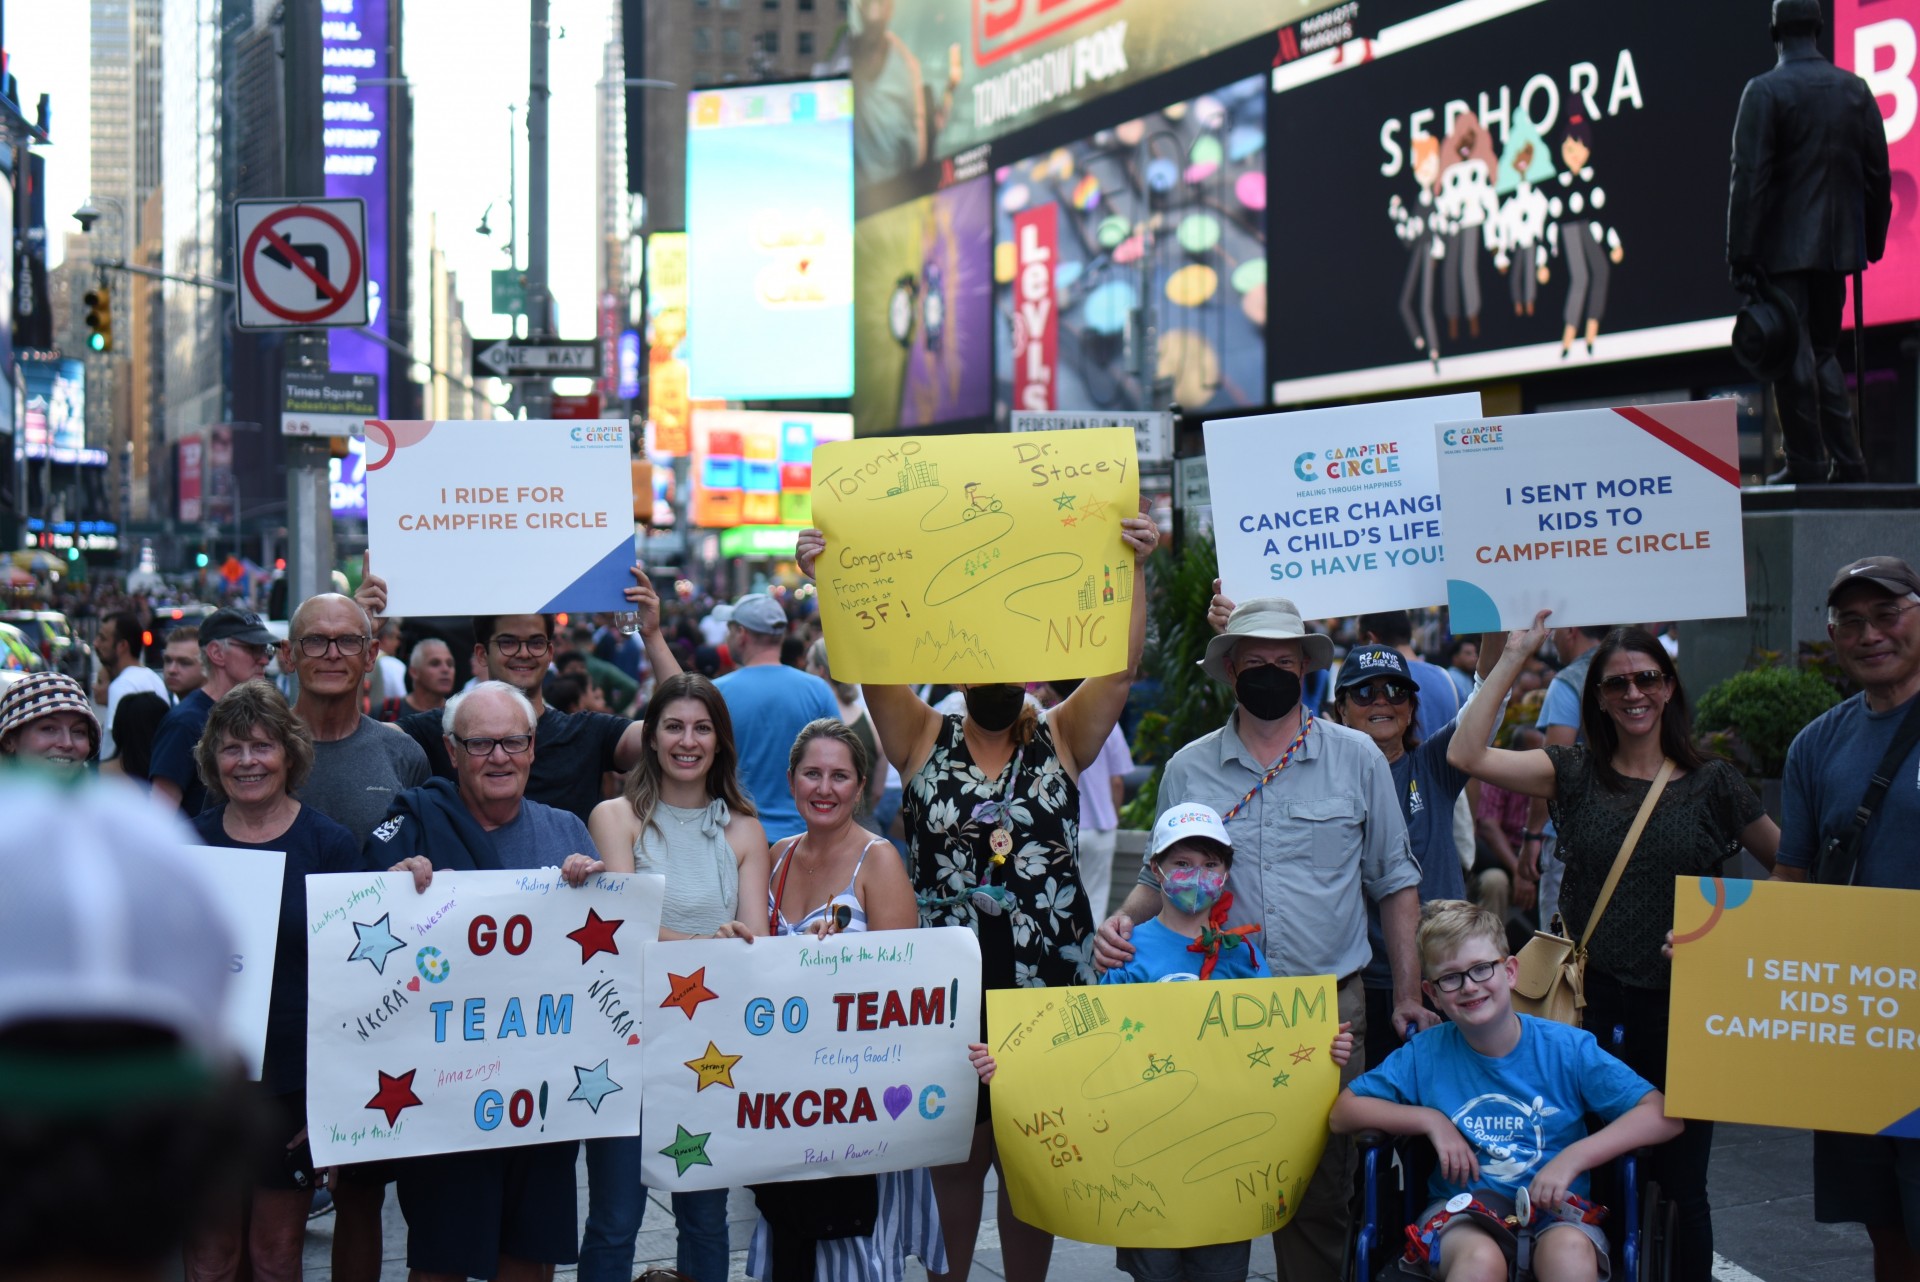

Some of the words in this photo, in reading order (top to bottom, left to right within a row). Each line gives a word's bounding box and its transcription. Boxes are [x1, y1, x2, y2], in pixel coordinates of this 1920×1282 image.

[1073, 20, 1128, 89] FOX
[1381, 49, 1644, 177] SEPHORA
[492, 350, 528, 364] ONE
[546, 350, 585, 364] WAY
[286, 385, 320, 398] Times
[322, 386, 364, 400] Square
[287, 399, 343, 412] Pedestrian
[345, 401, 374, 413] Plaza
[586, 433, 623, 442] CIRCLE
[1018, 418, 1086, 432] PEDESTRIAN
[1461, 425, 1503, 435] CAMPFIRE
[1461, 433, 1504, 445] CIRCLE
[1012, 442, 1059, 465] Dr.
[1325, 442, 1399, 460] CAMPFIRE
[818, 441, 921, 502] Toronto
[1030, 457, 1127, 487] Stacey
[1326, 455, 1401, 479] CIRCLE
[441, 488, 447, 504] I
[455, 487, 509, 504] RIDE
[517, 486, 565, 503] FOR
[1296, 488, 1327, 498] HEALING
[1328, 484, 1362, 495] THROUGH
[1364, 480, 1402, 491] HAPPINESS
[1505, 487, 1512, 505] I
[1521, 481, 1588, 505] SENT
[1596, 476, 1673, 499] MORE
[398, 513, 518, 531] CAMPFIRE
[525, 511, 608, 529] CIRCLE
[1239, 505, 1340, 533] CANCER
[1347, 494, 1442, 521] CHANG
[1538, 509, 1599, 532] KIDS
[1606, 507, 1643, 527] TO
[1263, 538, 1281, 557] A
[1287, 526, 1382, 553] CHILD'S
[1475, 537, 1608, 565] CAMPFIRE
[1616, 530, 1711, 554] CIRCLE
[839, 546, 913, 572] Congrats
[1270, 561, 1303, 581] SO
[1311, 552, 1378, 577] HAVE
[1385, 545, 1445, 568] YOU!
[832, 577, 869, 597] From
[873, 575, 895, 588] the
[840, 593, 878, 612] Nurses
[882, 591, 893, 599] at
[1045, 613, 1107, 654] NYC
[556, 875, 570, 890] for
[311, 905, 347, 934] Looking
[467, 914, 533, 956] GO
[799, 947, 838, 976] Riding
[841, 946, 853, 964] for
[859, 946, 874, 961] the
[878, 942, 914, 965] Kids!!
[1747, 958, 1754, 979] I
[1764, 959, 1840, 984] SENT
[1850, 965, 1920, 991] MOR
[744, 996, 809, 1036] GO
[833, 977, 958, 1032] TEAM!
[1197, 986, 1326, 1041] ADAM
[1780, 990, 1849, 1015] KIDS
[1858, 995, 1900, 1018] TO
[430, 994, 574, 1043] TEAM
[998, 1002, 1054, 1053] Toronto
[1705, 1014, 1856, 1046] CAMPFIRE
[813, 1045, 859, 1074] Feeling
[863, 1043, 902, 1064] Good!!
[474, 1080, 548, 1133] GO!
[737, 1087, 878, 1130] NKCRA
[1013, 1107, 1067, 1137] WAY
[1463, 1116, 1524, 1131] GATHER
[1474, 1128, 1515, 1142] Round
[351, 1127, 366, 1146] got
[1040, 1132, 1069, 1151] TO
[804, 1147, 835, 1165] Pedal
[844, 1141, 888, 1161] Power!!
[1051, 1144, 1084, 1168] GO!
[1235, 1159, 1290, 1203] NYC
